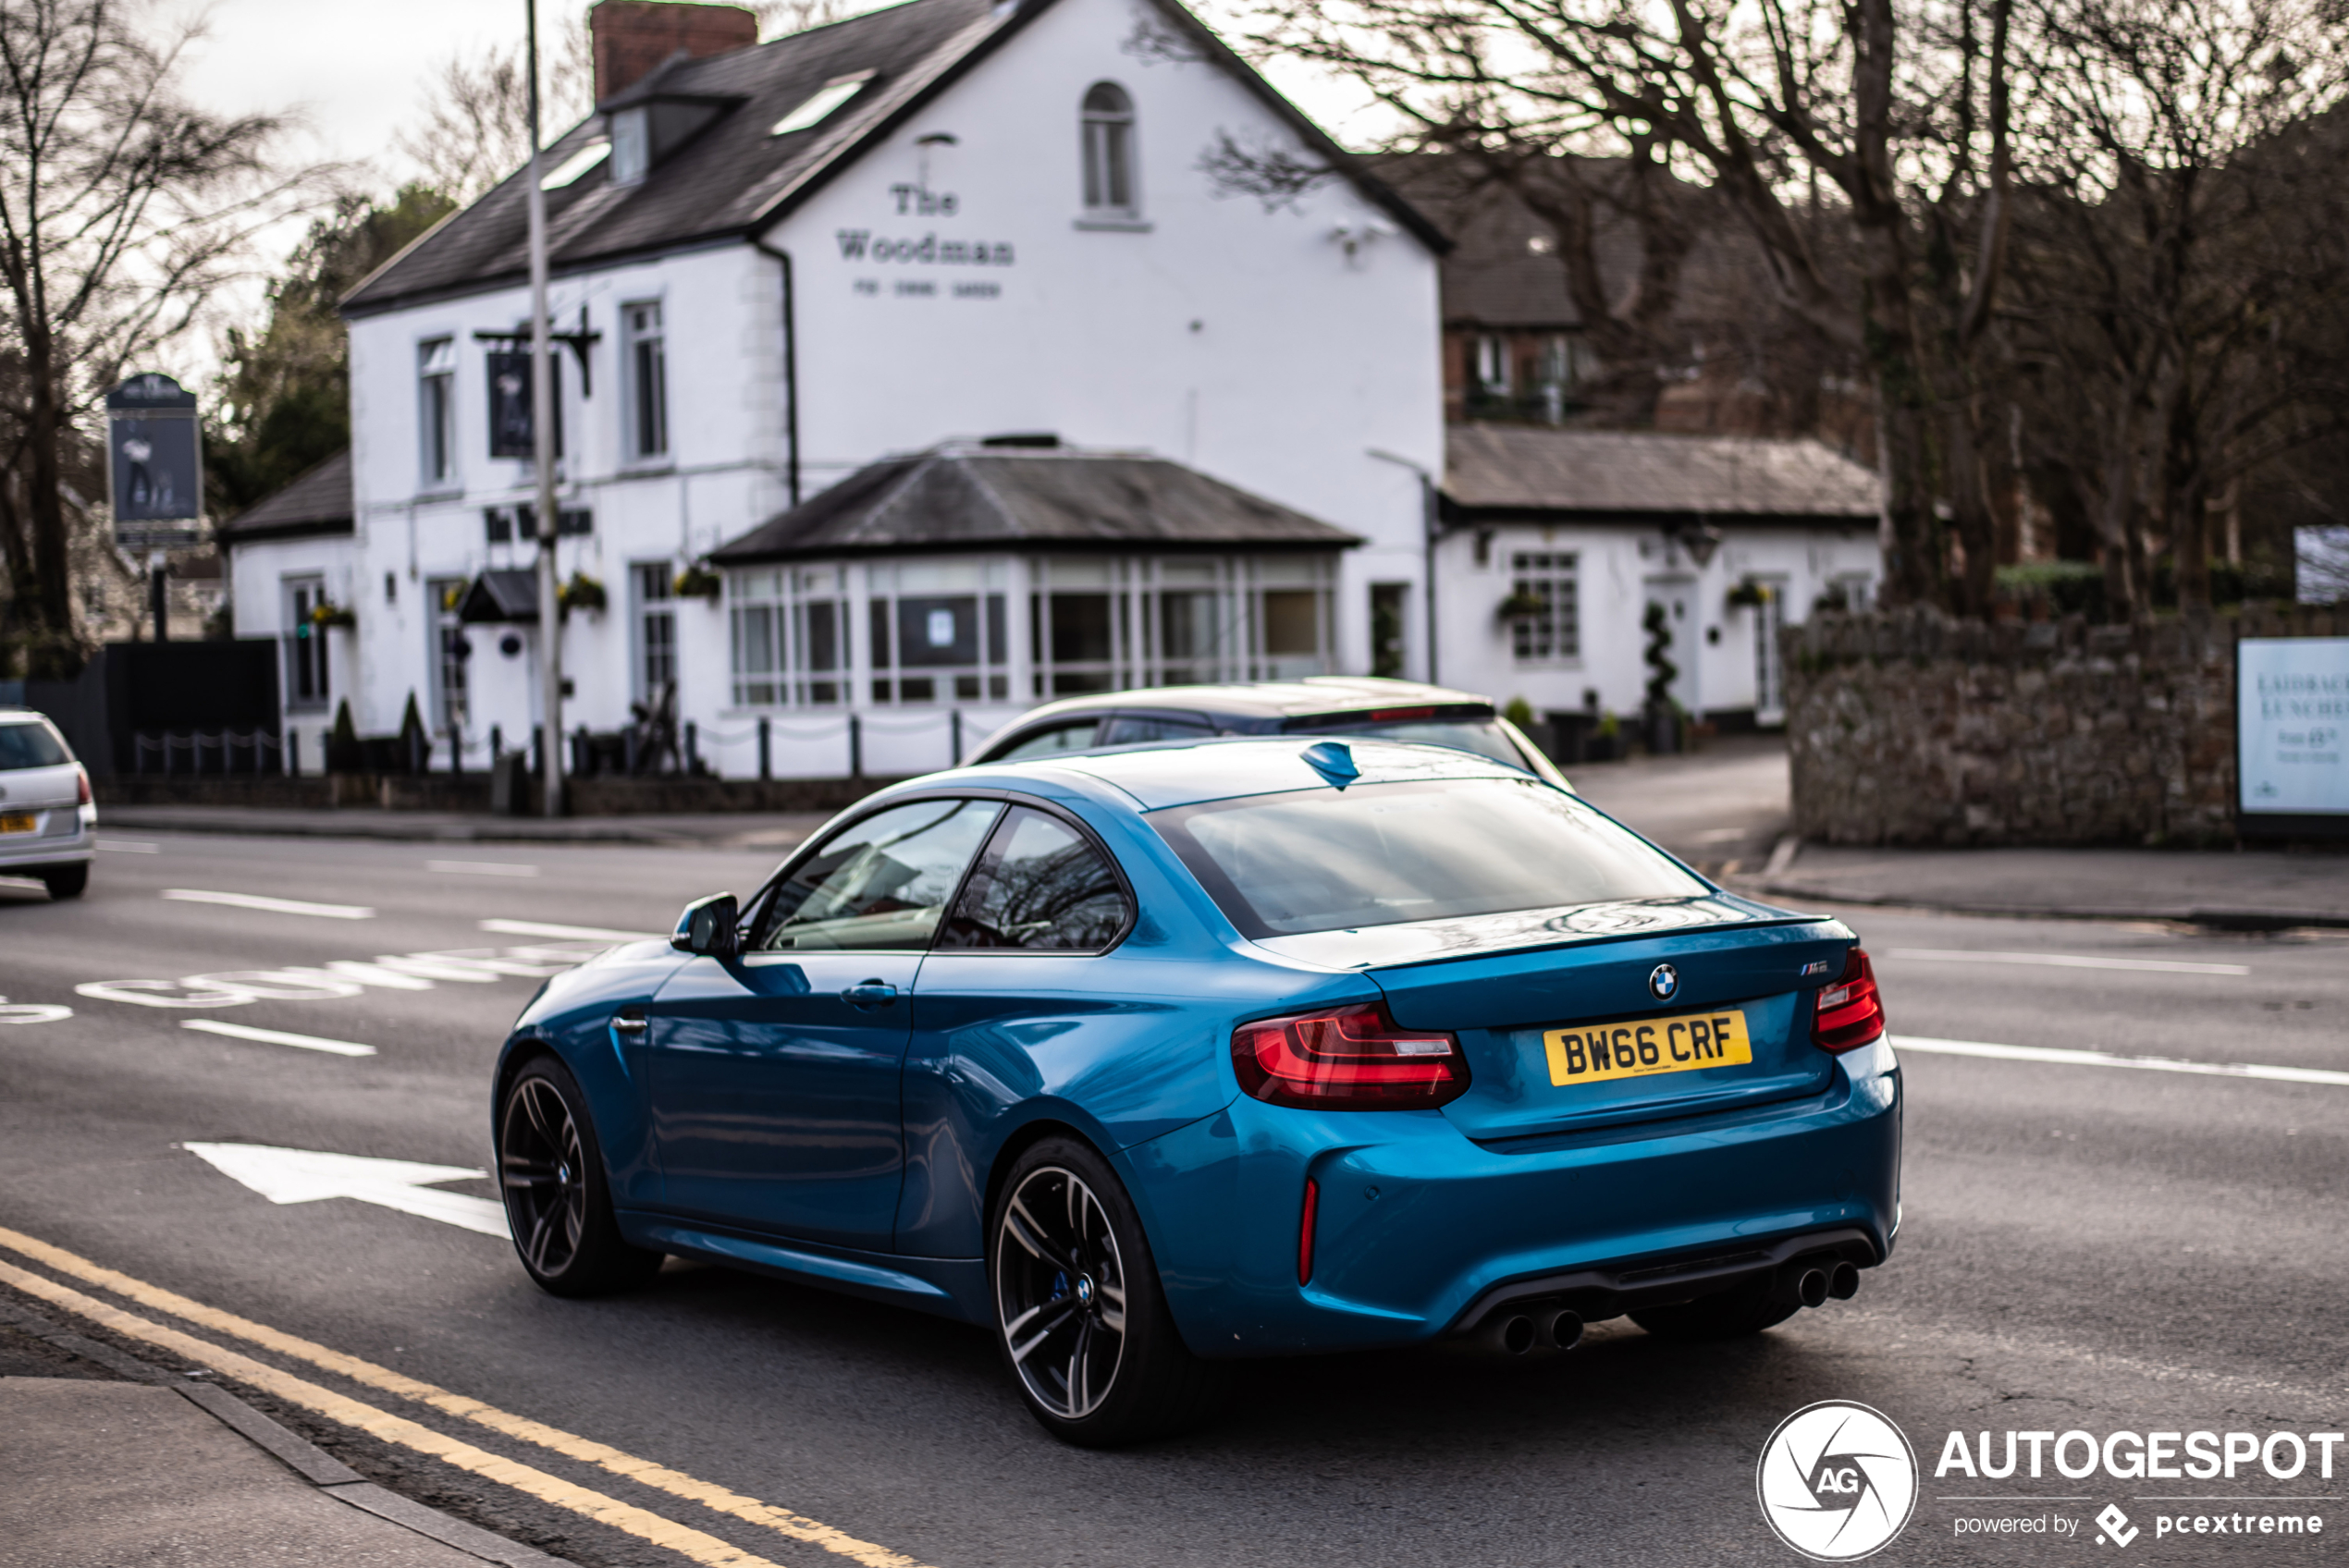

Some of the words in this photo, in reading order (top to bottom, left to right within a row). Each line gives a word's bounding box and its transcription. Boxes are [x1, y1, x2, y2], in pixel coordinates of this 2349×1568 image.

[890, 183, 959, 216] The
[836, 230, 1015, 265] Woodman
[1561, 1025, 1660, 1074] BW66
[1667, 1017, 1731, 1061] CRF
